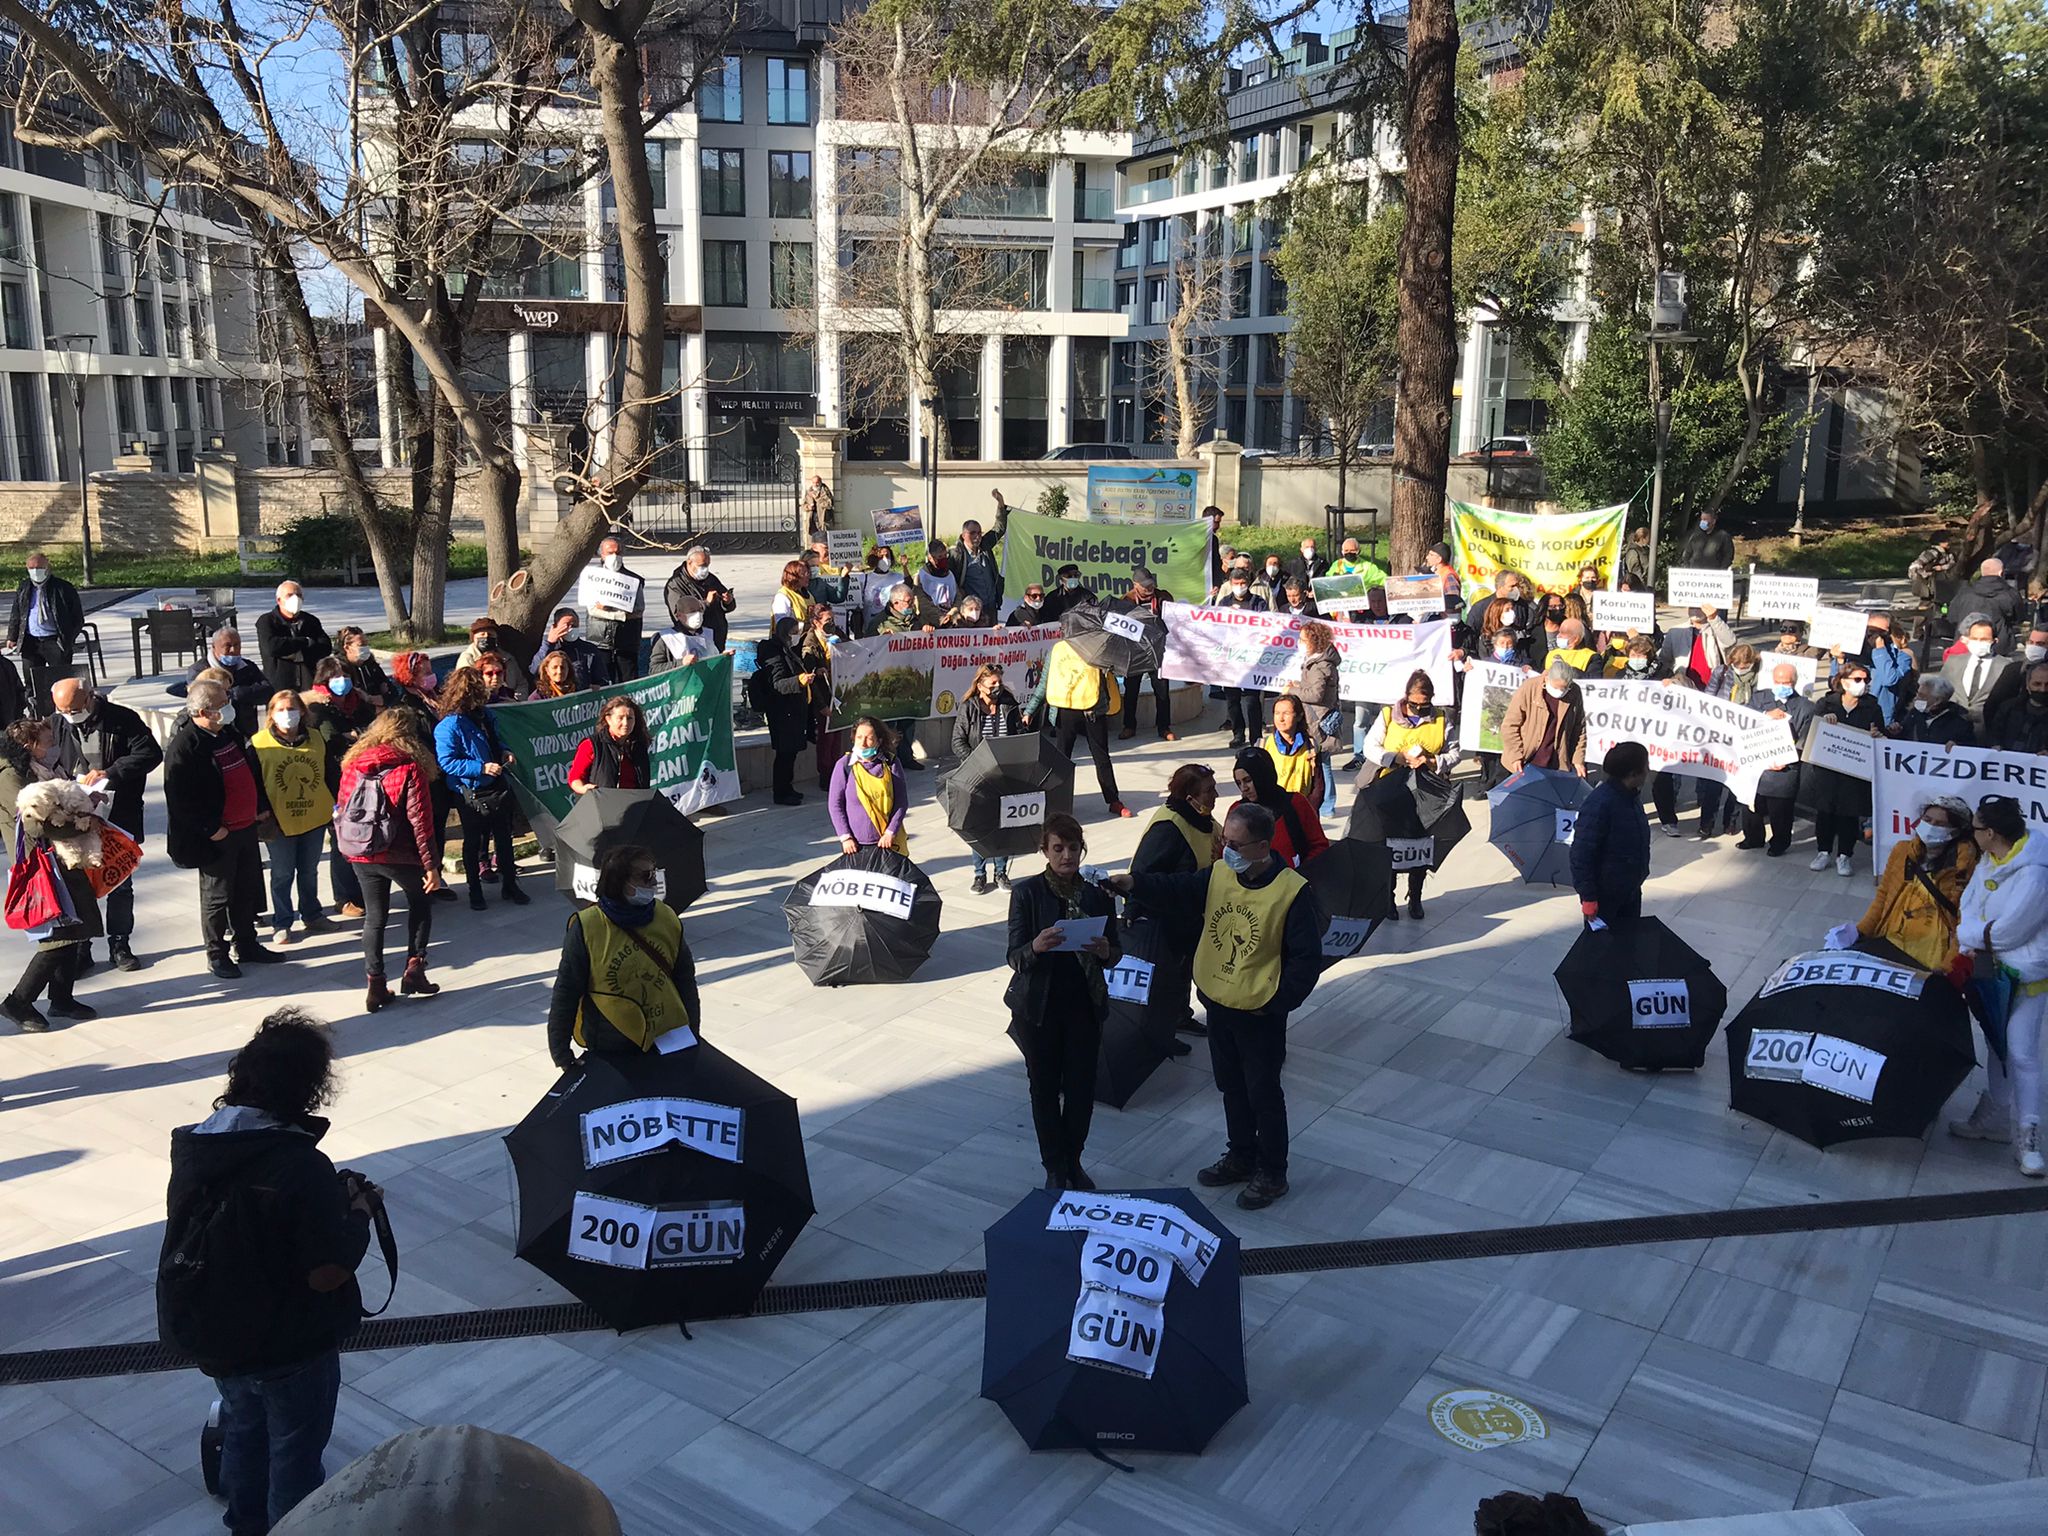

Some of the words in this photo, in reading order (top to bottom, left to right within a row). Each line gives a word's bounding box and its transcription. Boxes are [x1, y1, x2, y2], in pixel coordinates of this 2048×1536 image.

[523, 311, 559, 328] wep
[720, 400, 738, 409] WEP
[741, 400, 770, 410] HEALTH
[775, 400, 803, 410] TRAVEL
[1541, 535, 1606, 551] KORUSU
[830, 551, 862, 560] DOKUNMA
[1034, 534, 1168, 571] Validebağ'a
[1510, 557, 1531, 570] SİT
[588, 574, 631, 590] Koru'ma
[1678, 580, 1723, 589] OTOPARK
[1600, 599, 1646, 609] Koru'ma
[1672, 590, 1729, 600] YAPILAMAZ!
[1782, 591, 1815, 599] TALANA
[1762, 601, 1800, 610] HAYIR
[1110, 616, 1138, 634] 200
[1596, 613, 1651, 623] Dokunma!
[888, 633, 934, 652] VALİDEBAĞ
[936, 635, 971, 648] KORUSU
[973, 635, 981, 647] 1.
[941, 654, 968, 671] Düğün
[1585, 684, 1630, 701] Park
[1637, 687, 1692, 714] değil,
[1585, 711, 1668, 737] KORUYU
[1681, 748, 1700, 763] SİT
[1739, 744, 1793, 765] DOKUNMA
[1884, 746, 2048, 789] İKİZDERE
[1006, 803, 1040, 819] 200
[1391, 845, 1432, 864] GÜN
[817, 878, 912, 908] NÖBETTE
[1208, 901, 1234, 952] VALİDEBAĞ
[1236, 904, 1262, 960] GÖNÜLLÜLERİ
[1323, 931, 1361, 947] 200
[1635, 991, 1686, 1017] GÜN
[1752, 1038, 1804, 1064] 200
[1811, 1047, 1868, 1081] GÜN
[592, 1111, 738, 1150] NÖBETTE
[580, 1214, 640, 1249] 200
[655, 1212, 742, 1256] GÜN
[1057, 1201, 1215, 1268] NÖBETTE
[758, 1225, 784, 1262] INESIS
[1092, 1242, 1160, 1283] 200
[1077, 1309, 1157, 1357] GÜN
[1096, 1431, 1136, 1440] BEKO
